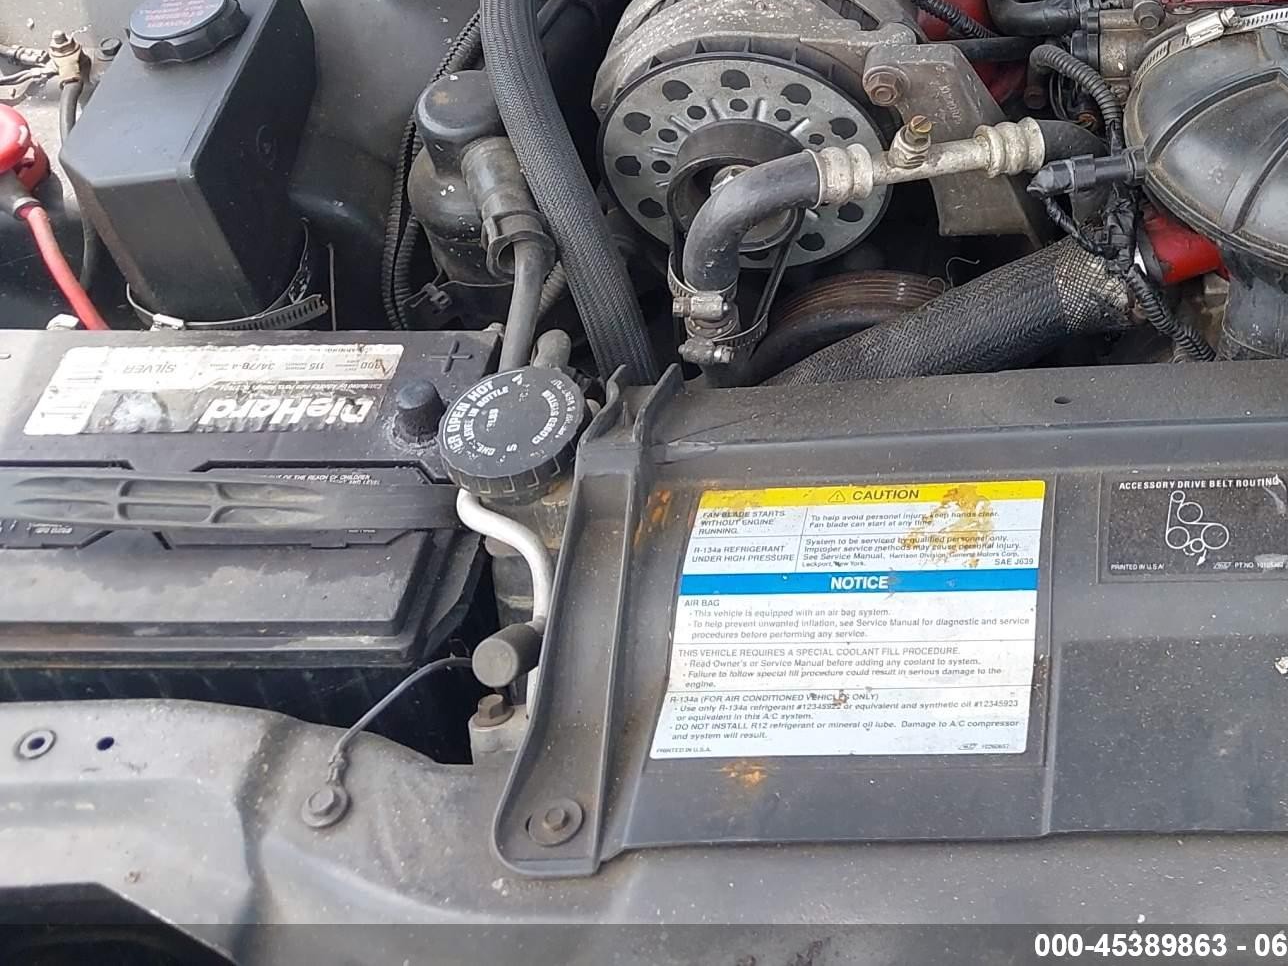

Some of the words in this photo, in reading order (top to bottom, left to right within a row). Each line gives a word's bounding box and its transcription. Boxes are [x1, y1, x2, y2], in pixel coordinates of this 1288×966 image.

[476, 386, 509, 407] BOTTLE
[198, 397, 375, 425] DieHard
[447, 402, 470, 433] OPEN
[467, 381, 495, 402] HOT
[1119, 481, 1175, 490] ACCESSORY
[1178, 480, 1206, 488] DRIVE
[1210, 479, 1232, 487] BELT
[1236, 477, 1279, 487] ROUTING
[852, 489, 920, 500] CAUTION
[842, 513, 864, 521] avoid
[805, 539, 836, 547] System
[822, 552, 855, 560] Service
[831, 576, 889, 589] NOTICE
[702, 599, 720, 607] BAG
[713, 609, 743, 617] vehicle
[754, 609, 793, 618] equipped
[796, 609, 813, 617] with
[841, 609, 856, 617] bag
[704, 620, 723, 628] help
[725, 620, 756, 628] prevent
[856, 618, 887, 626] Service
[889, 618, 919, 626] Manual
[922, 618, 933, 626] for
[936, 618, 979, 627] diagnostic
[692, 631, 738, 640] procedures
[769, 630, 815, 640] performing
[817, 631, 831, 639] any
[679, 649, 698, 657] THIS
[700, 649, 736, 657] VEHICLE
[739, 648, 785, 657] REQUIRES
[796, 648, 833, 656] SPECIAL
[836, 647, 879, 656] COOLANT
[713, 659, 747, 667] Owner's
[761, 659, 791, 667] Service
[794, 659, 824, 667] Manual
[855, 658, 883, 667] adding
[886, 659, 900, 667] any
[903, 658, 935, 666] coolant
[756, 669, 786, 678] special
[801, 669, 843, 678] procedure
[846, 668, 870, 676] could
[872, 668, 896, 676] result
[942, 667, 975, 676] damage
[742, 694, 804, 702] CONDITIONED
[680, 704, 696, 712] Use
[698, 704, 717, 712] only
[920, 702, 958, 710] synthetic
[675, 723, 688, 731] DO
[690, 722, 709, 730] NOT
[712, 722, 748, 730] INSTALL
[901, 720, 936, 729] Damage
[968, 721, 1019, 729] compressor
[690, 732, 721, 741] system
